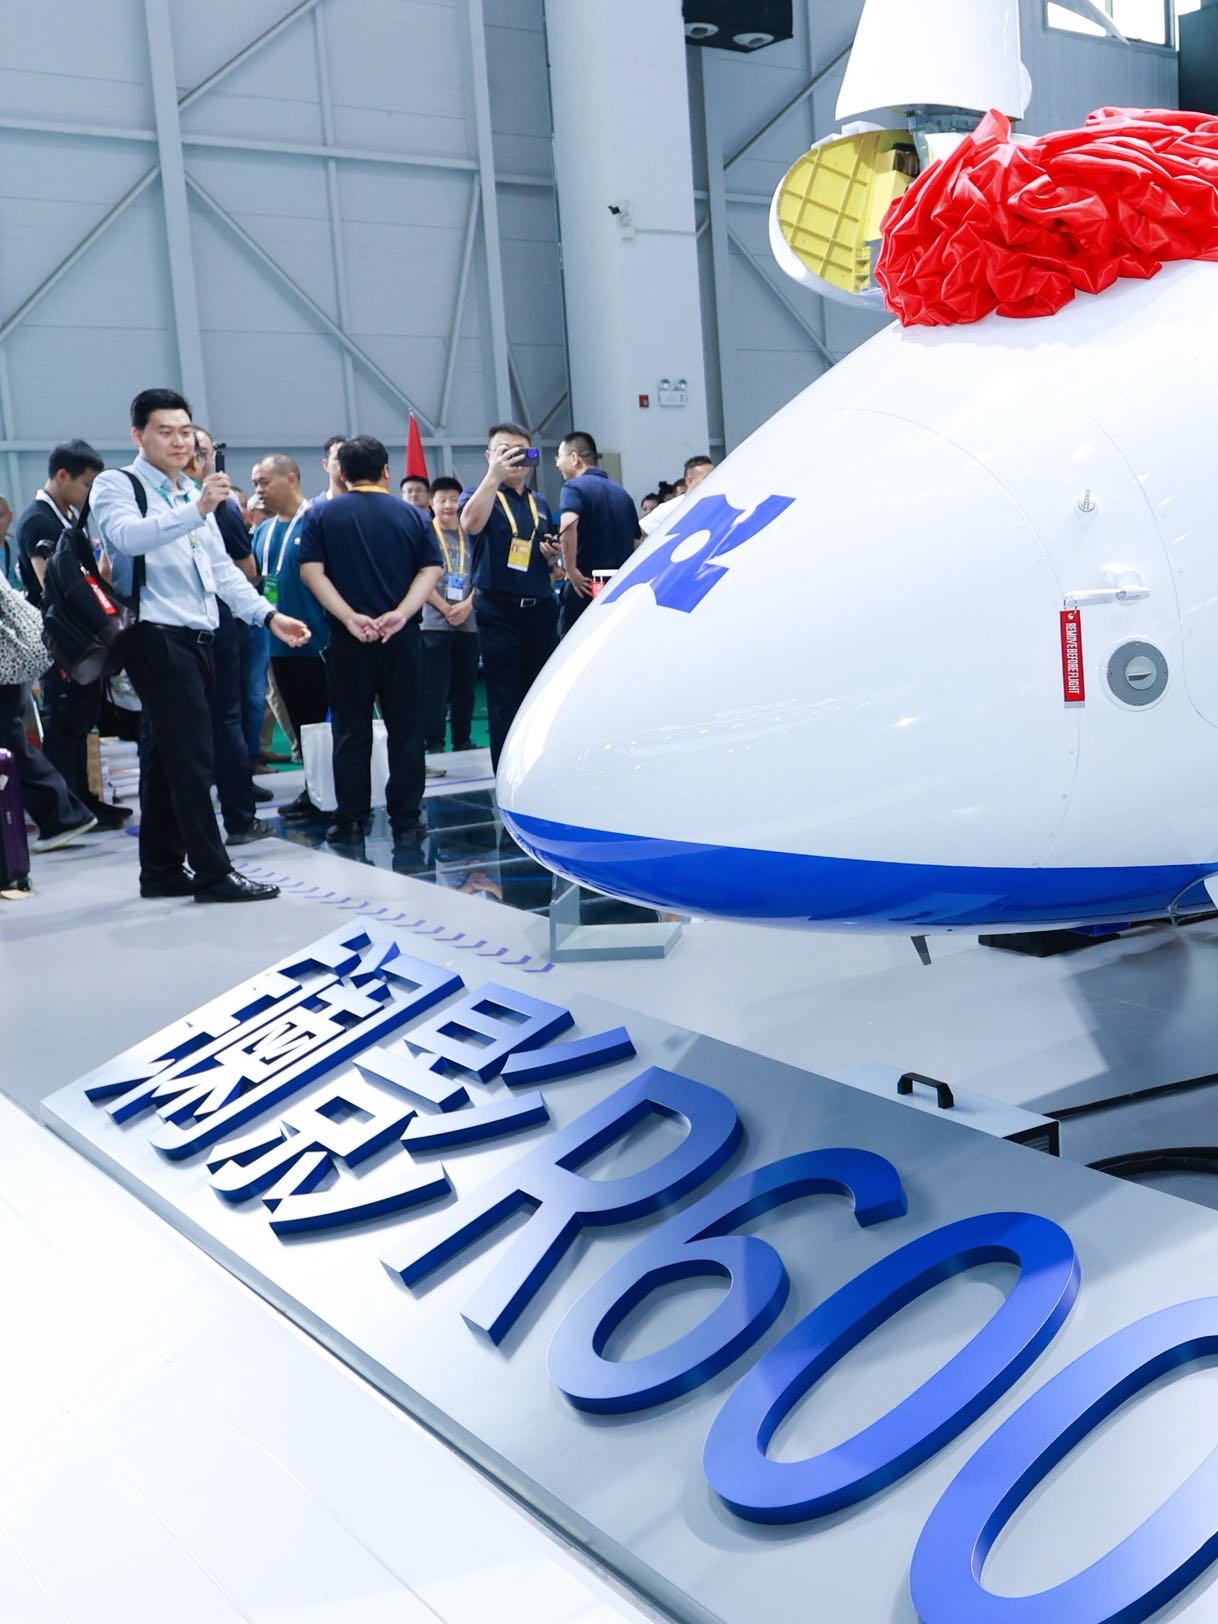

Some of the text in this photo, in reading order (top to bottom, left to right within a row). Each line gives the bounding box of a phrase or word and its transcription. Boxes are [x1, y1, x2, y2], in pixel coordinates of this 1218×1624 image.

[1066, 623, 1079, 694] REMOVE BEFORE FLIGHT
